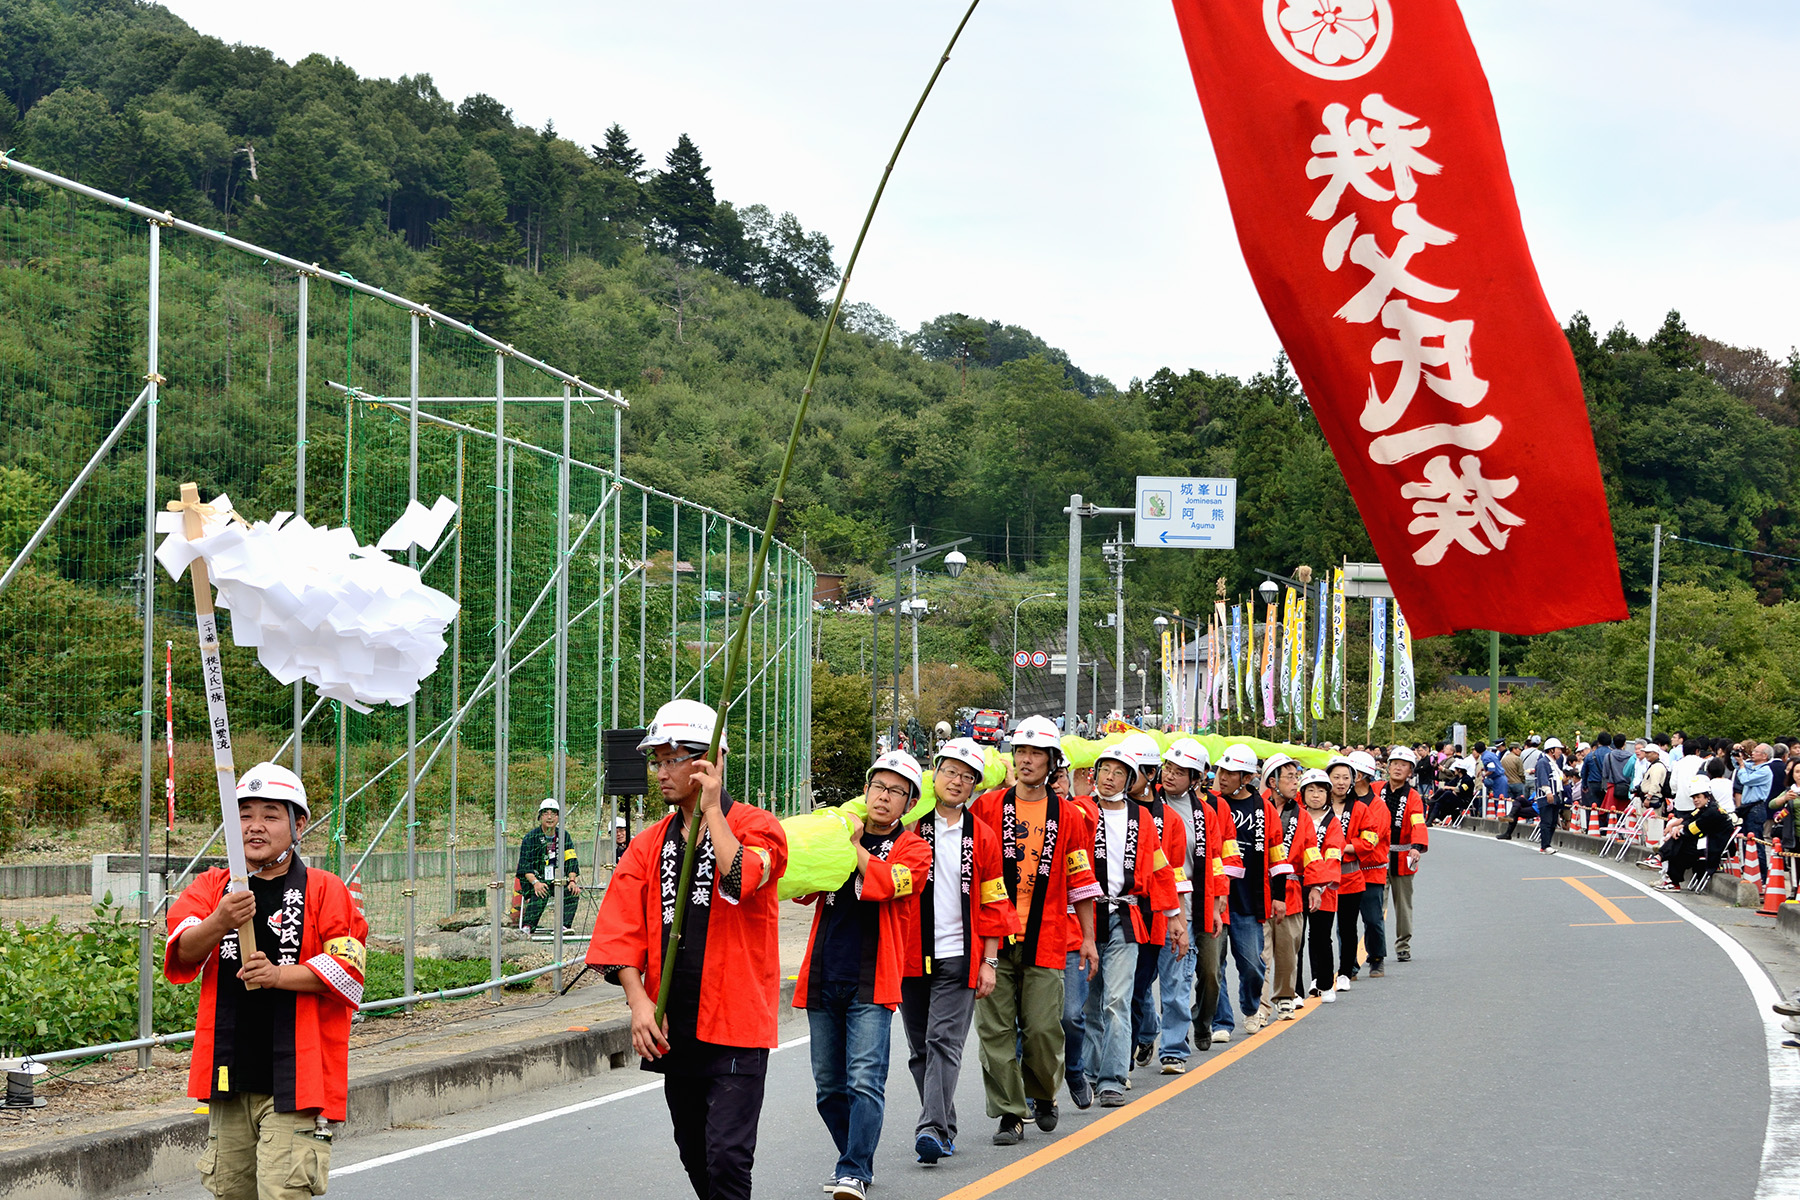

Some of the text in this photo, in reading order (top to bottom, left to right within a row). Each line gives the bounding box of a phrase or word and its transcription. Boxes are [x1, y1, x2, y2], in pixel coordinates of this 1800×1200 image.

[1180, 483, 1228, 496] 城峯山
[1185, 497, 1222, 505] Jominesan
[1182, 508, 1225, 521] 阿熊
[1190, 522, 1215, 530] Aguma
[203, 620, 216, 642] 二十番
[205, 656, 224, 703] 秩父氏一族
[1035, 655, 1044, 663] 40
[1003, 803, 1017, 859] 秩父氏一族
[1038, 818, 1058, 877] 秩父氏一族
[1123, 818, 1139, 871] 秩父氏一族
[1193, 809, 1206, 858] 秩父氏一族
[1254, 808, 1265, 852] 秩父氏一族
[961, 836, 974, 895] 秩父氏一族
